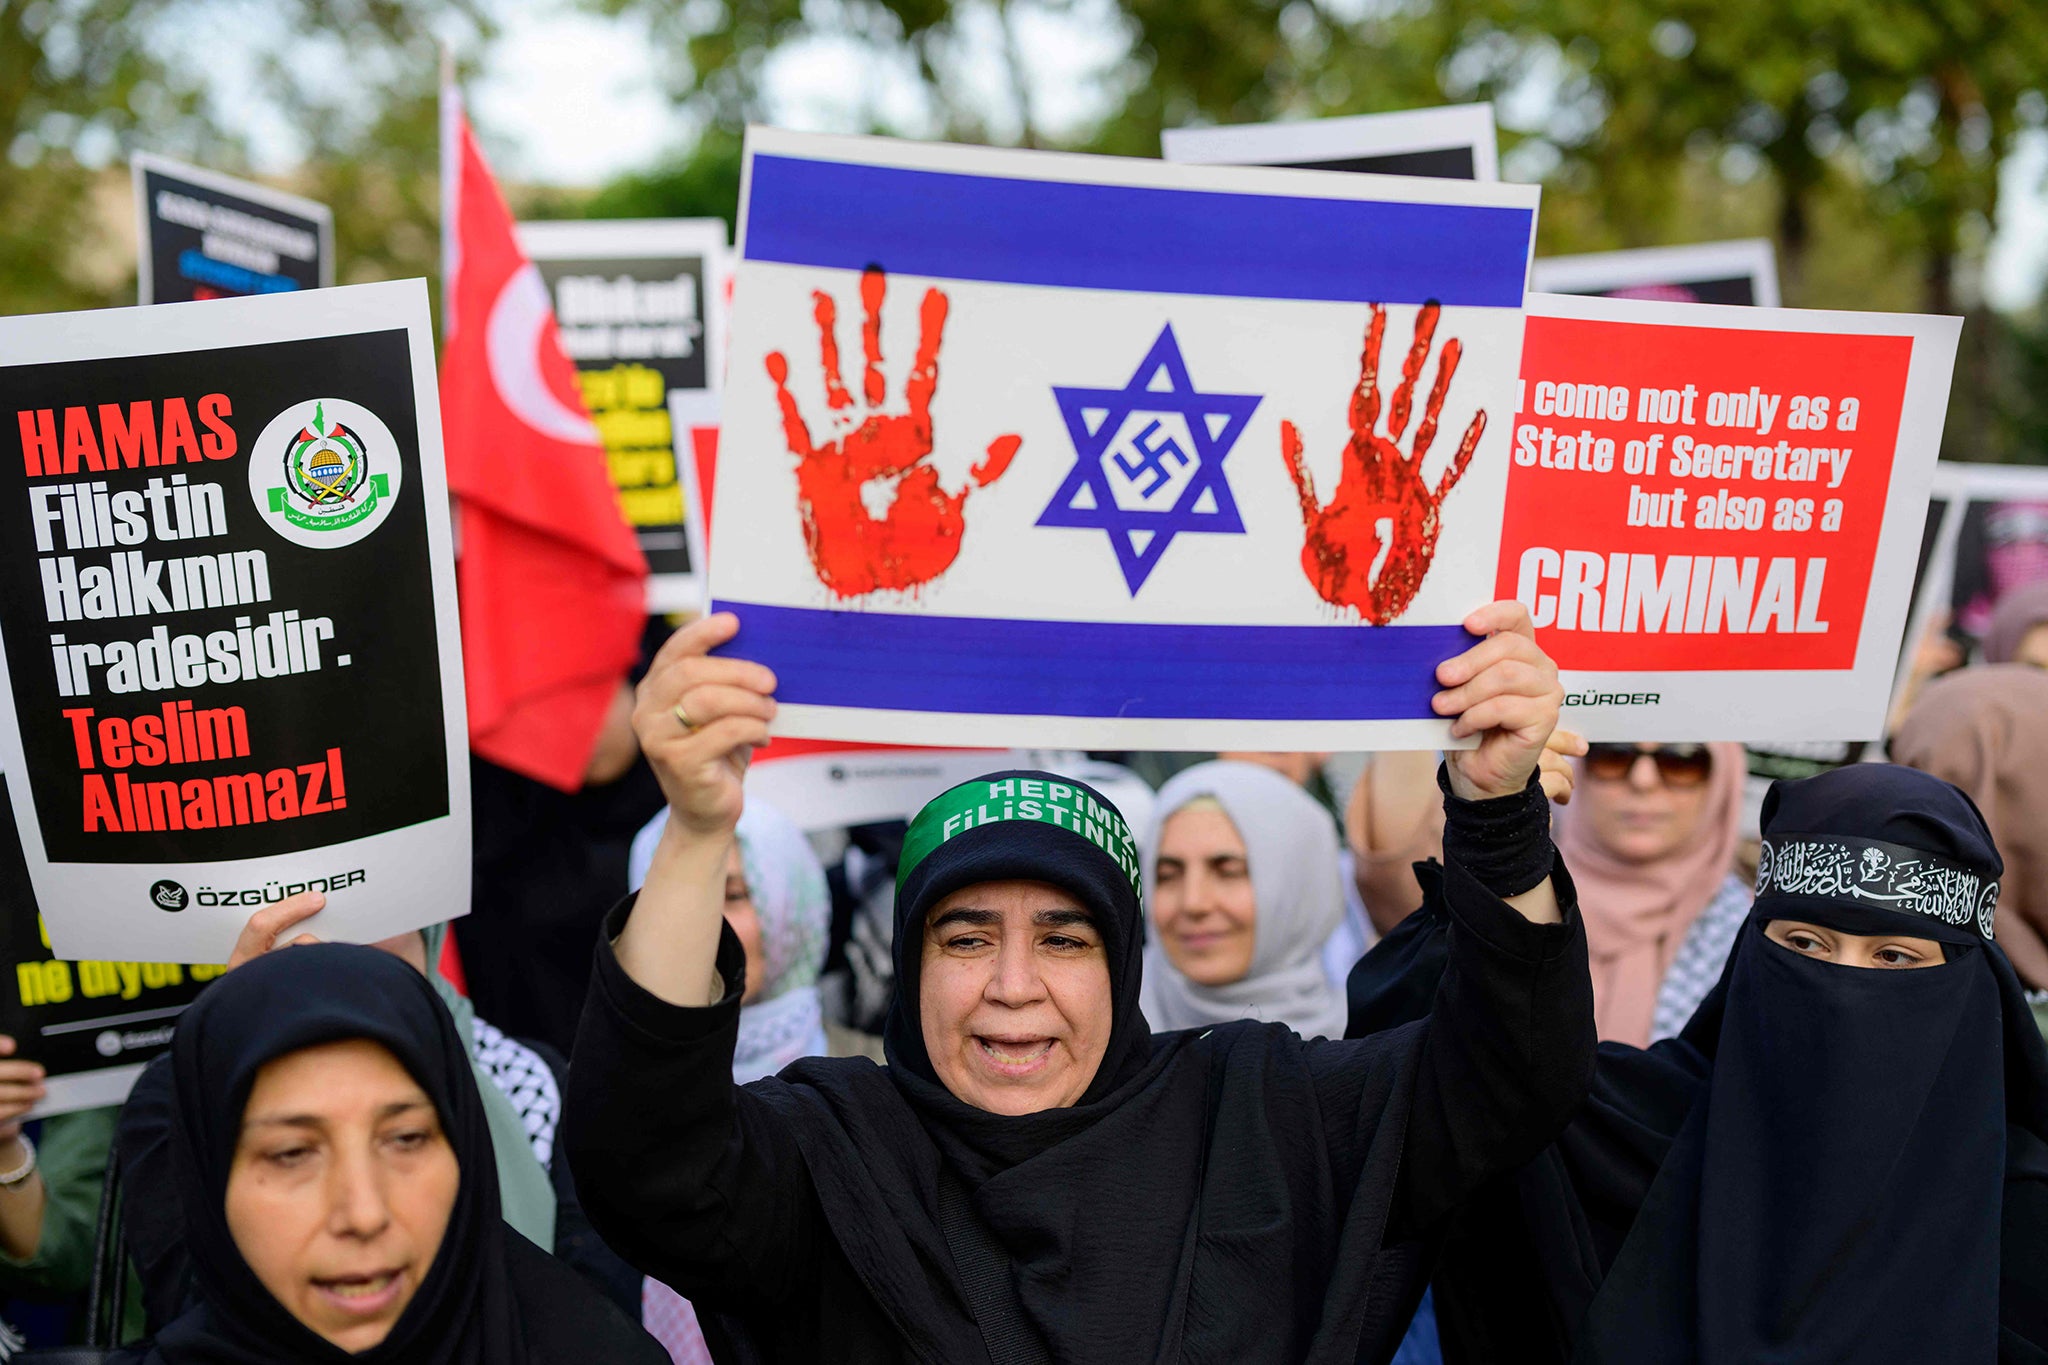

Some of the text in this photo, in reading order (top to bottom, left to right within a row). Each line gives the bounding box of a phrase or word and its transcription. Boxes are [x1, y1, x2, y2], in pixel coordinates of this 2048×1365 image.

[17, 392, 238, 477] HAMAS
[1534, 380, 1629, 421] come
[1637, 384, 1699, 425] not
[1705, 386, 1781, 435] only
[1787, 395, 1830, 432] as
[1837, 397, 1860, 432] a
[1515, 424, 1853, 489] State of Secretary
[28, 473, 228, 552] Filistin
[1627, 485, 1844, 532] but also as a
[38, 548, 272, 621] Halkının
[1516, 546, 1829, 634] CRIMINAL
[1560, 689, 1661, 706] GÜRDER
[61, 699, 251, 769] Teslim
[82, 746, 347, 833] Alınamaz!
[16, 960, 73, 1007] ne
